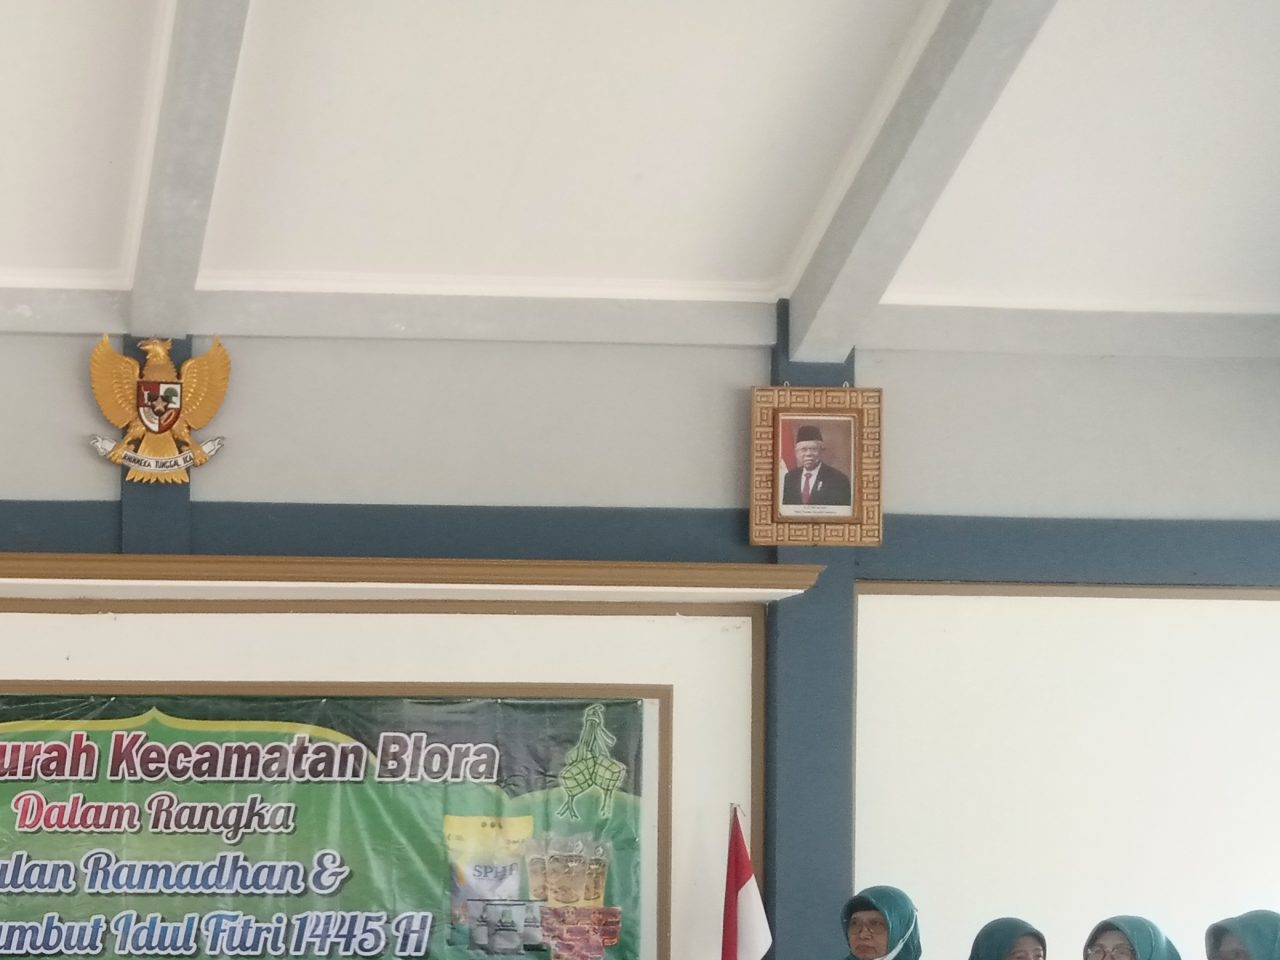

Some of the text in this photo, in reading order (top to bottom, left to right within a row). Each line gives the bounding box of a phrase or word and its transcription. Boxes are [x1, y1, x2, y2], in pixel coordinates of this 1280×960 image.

[108, 731, 369, 783] Kecamatan
[375, 732, 500, 783] Blora
[11, 790, 297, 844] Dalam Rangka
[81, 850, 303, 896] Ramadhan
[311, 849, 349, 895] &
[111, 912, 197, 956] Idul
[201, 912, 285, 957] Fitri
[291, 911, 387, 957] 1445
[393, 911, 433, 957] H
